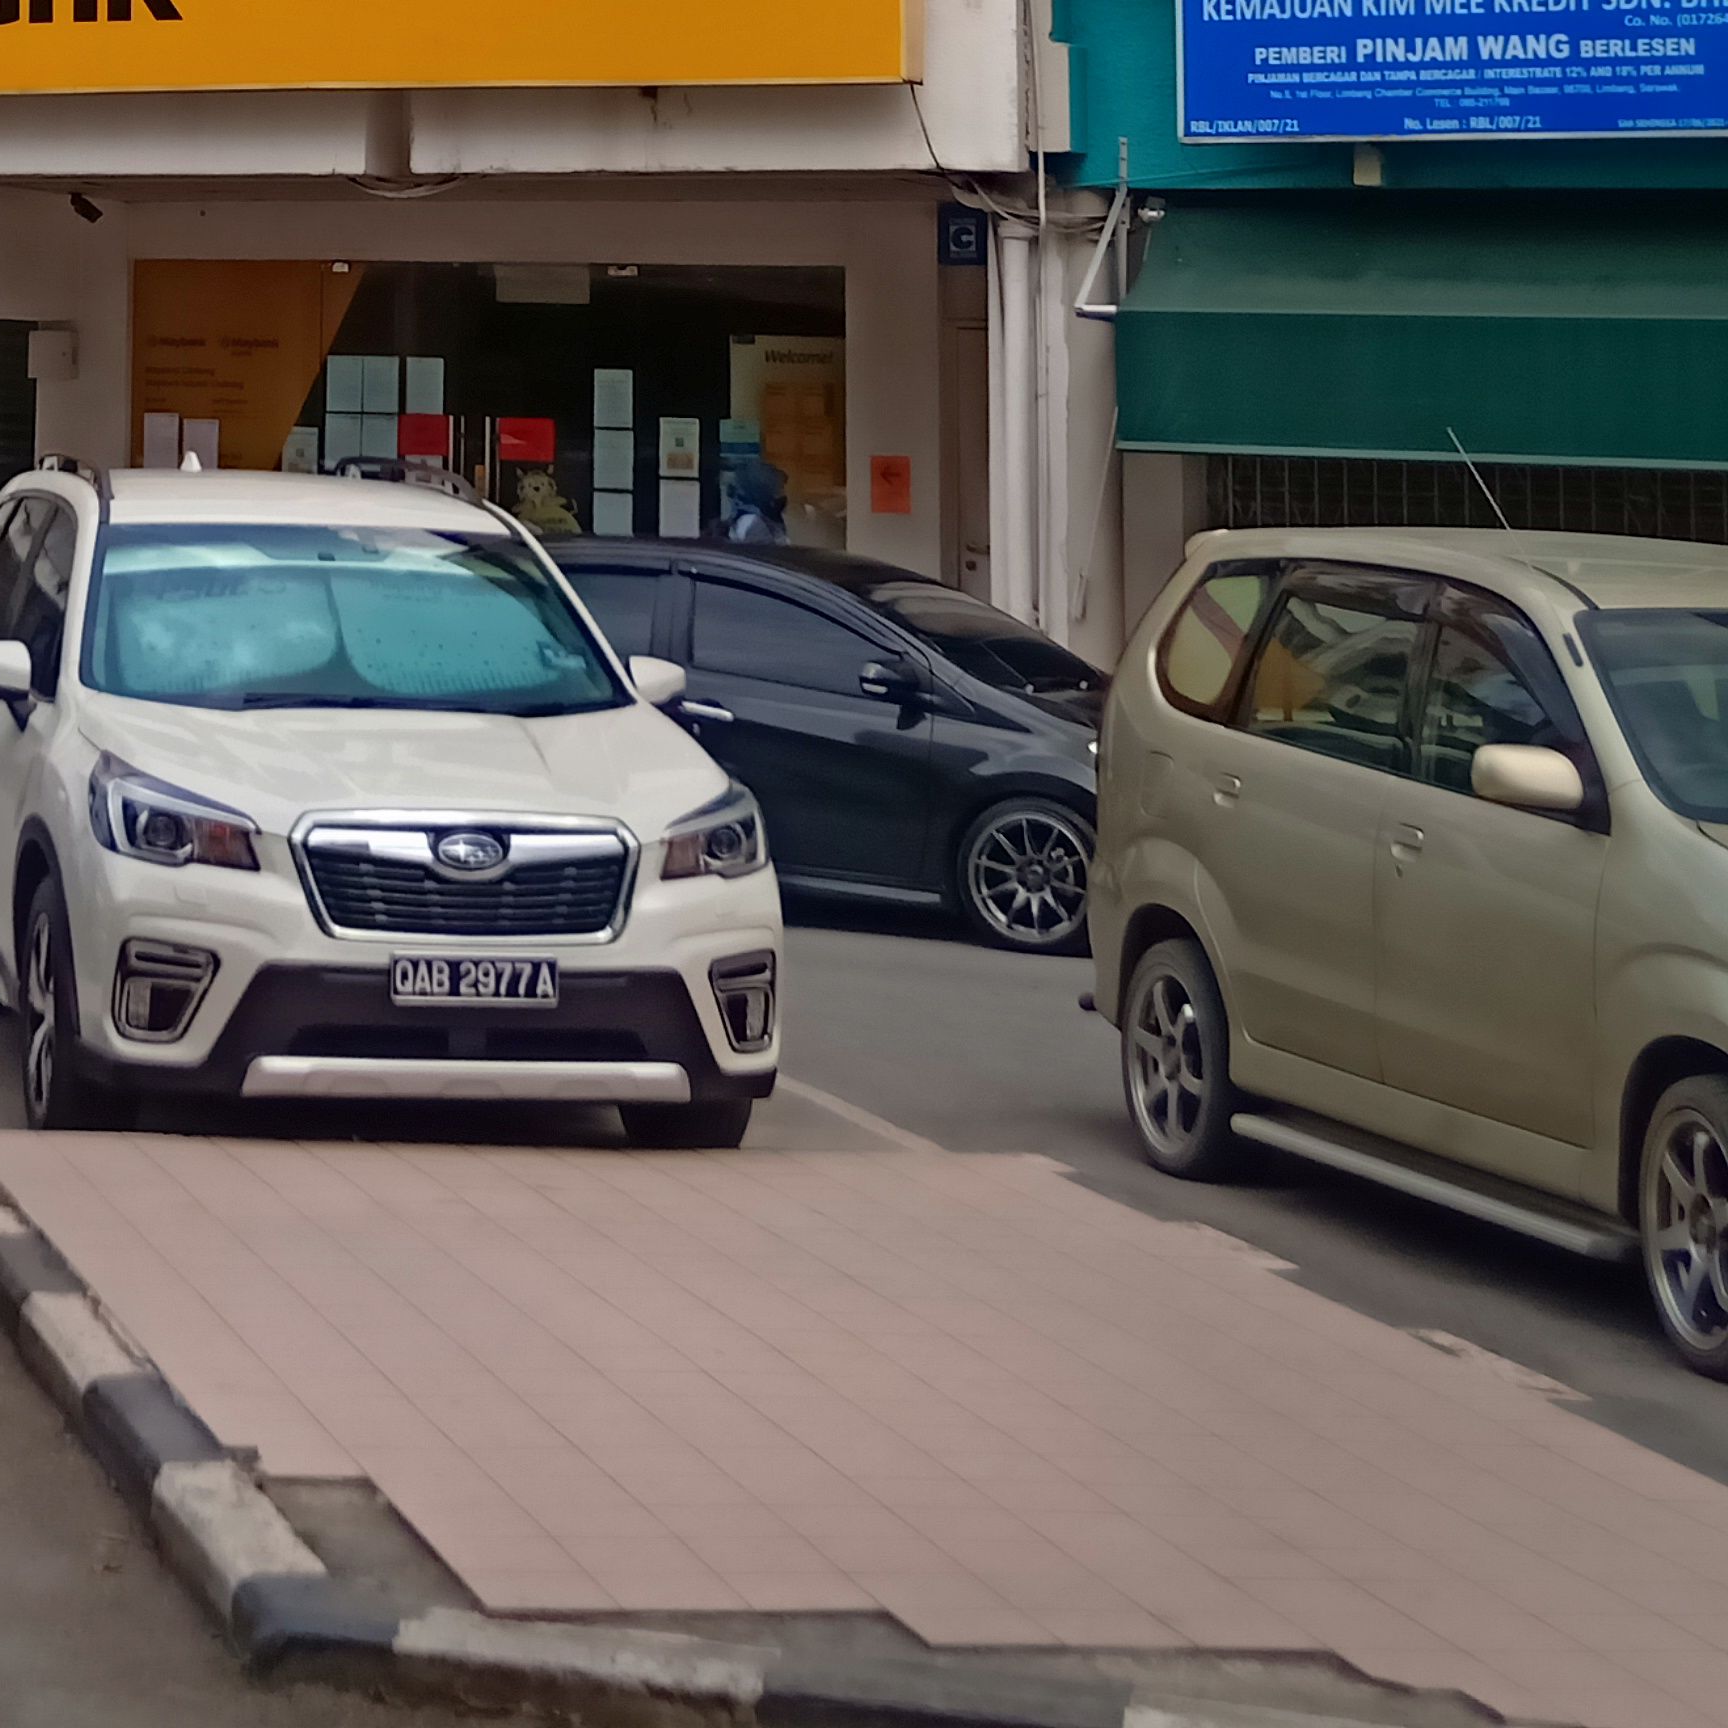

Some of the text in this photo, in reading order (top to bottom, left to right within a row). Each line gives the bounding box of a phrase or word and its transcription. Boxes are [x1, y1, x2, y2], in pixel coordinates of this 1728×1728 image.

[1624, 15, 1645, 27] Co.
[1650, 15, 1672, 27] No.
[1254, 33, 1696, 65] PEMBERI PINJAM WANG BERLESEN
[1640, 65, 1661, 76] PER
[1426, 116, 1460, 129] Lesen
[765, 350, 833, 364] Welcome!
[395, 959, 555, 998] QAB 2977A
